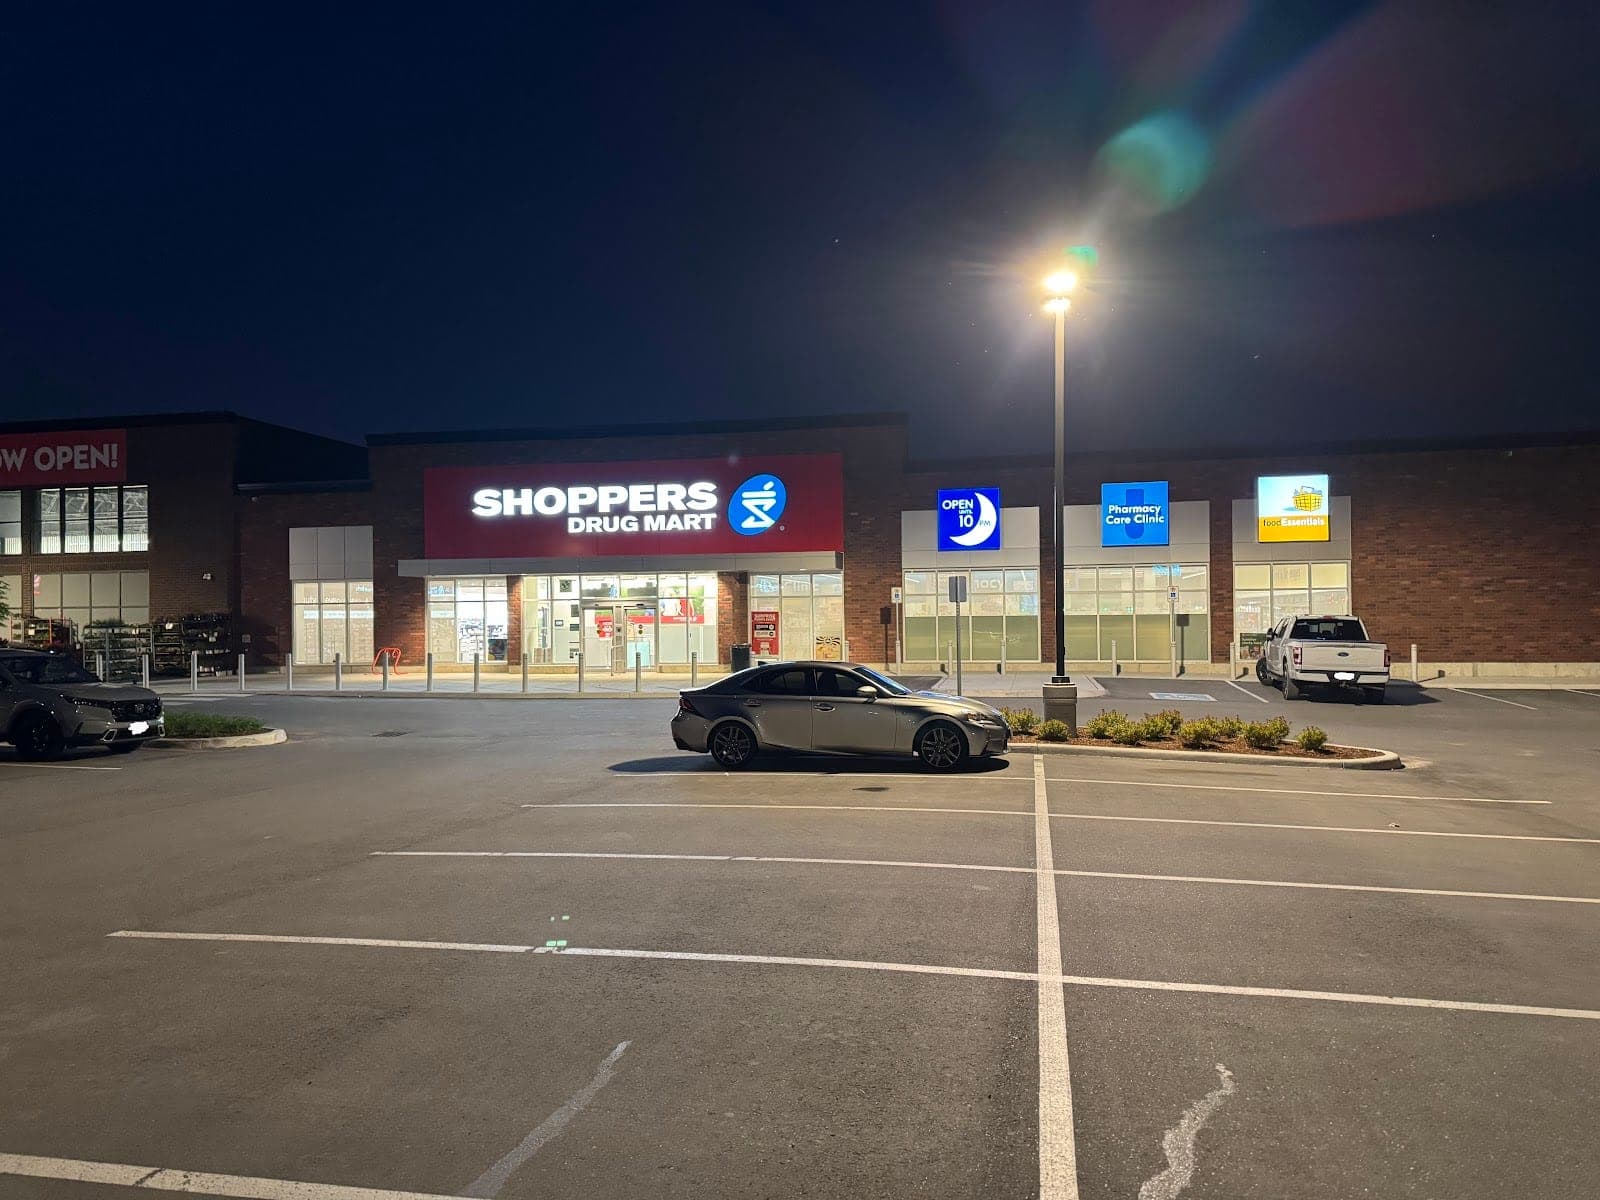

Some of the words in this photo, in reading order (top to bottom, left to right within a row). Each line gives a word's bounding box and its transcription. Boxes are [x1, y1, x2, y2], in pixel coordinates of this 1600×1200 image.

[33, 443, 118, 471] OPEN!
[471, 481, 718, 517] SHOPPERS
[942, 498, 974, 510] OPEN
[1108, 504, 1162, 515] Pharmacy
[567, 515, 639, 533] DRUG
[643, 513, 717, 531] MART
[959, 514, 974, 528] 10
[979, 519, 991, 527] PM
[1105, 515, 1131, 525] Care
[1134, 514, 1165, 524] Clinic
